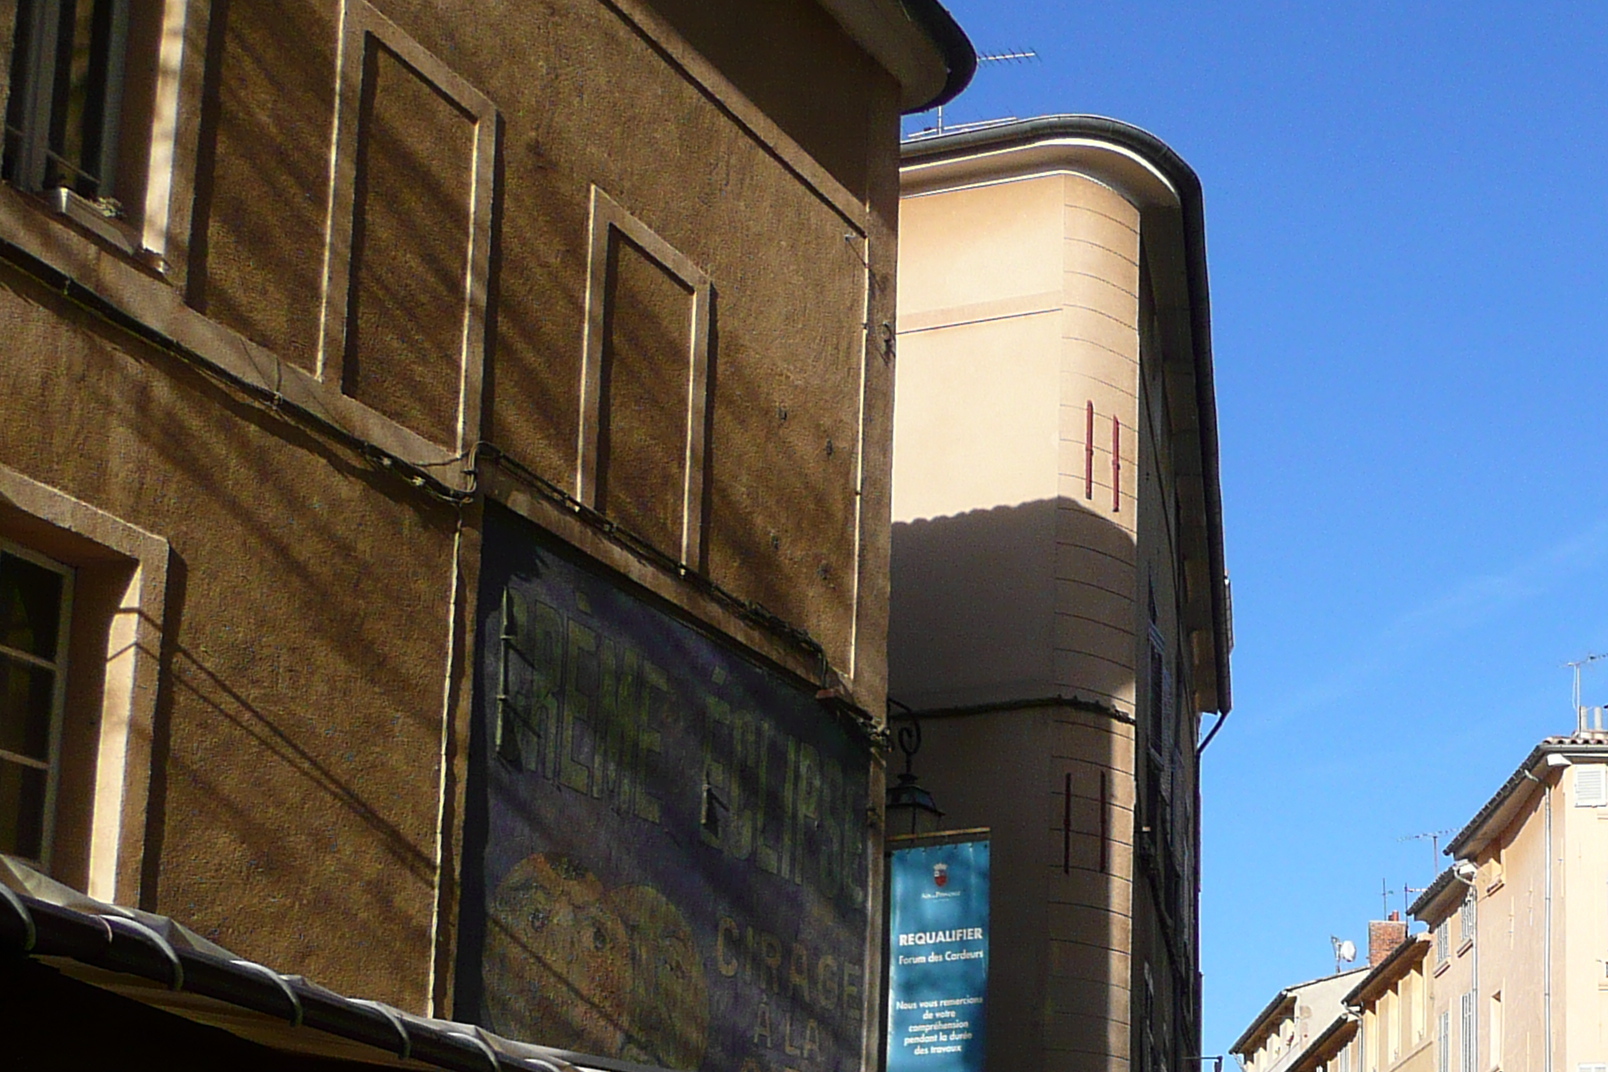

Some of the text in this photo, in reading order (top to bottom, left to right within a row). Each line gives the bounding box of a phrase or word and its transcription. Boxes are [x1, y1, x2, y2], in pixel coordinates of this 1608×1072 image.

[899, 928, 983, 946] REQUALIFIER
[899, 949, 984, 965] Forum des Cardeurs
[717, 917, 862, 1018] CIRAGE
[896, 994, 983, 1010] Nous vous remercions
[923, 1010, 956, 1019] de votre
[908, 1020, 969, 1034] compréhension
[785, 1012, 824, 1061] LA
[903, 1030, 973, 1046] pendant la durée
[914, 1045, 962, 1055] des travaux
